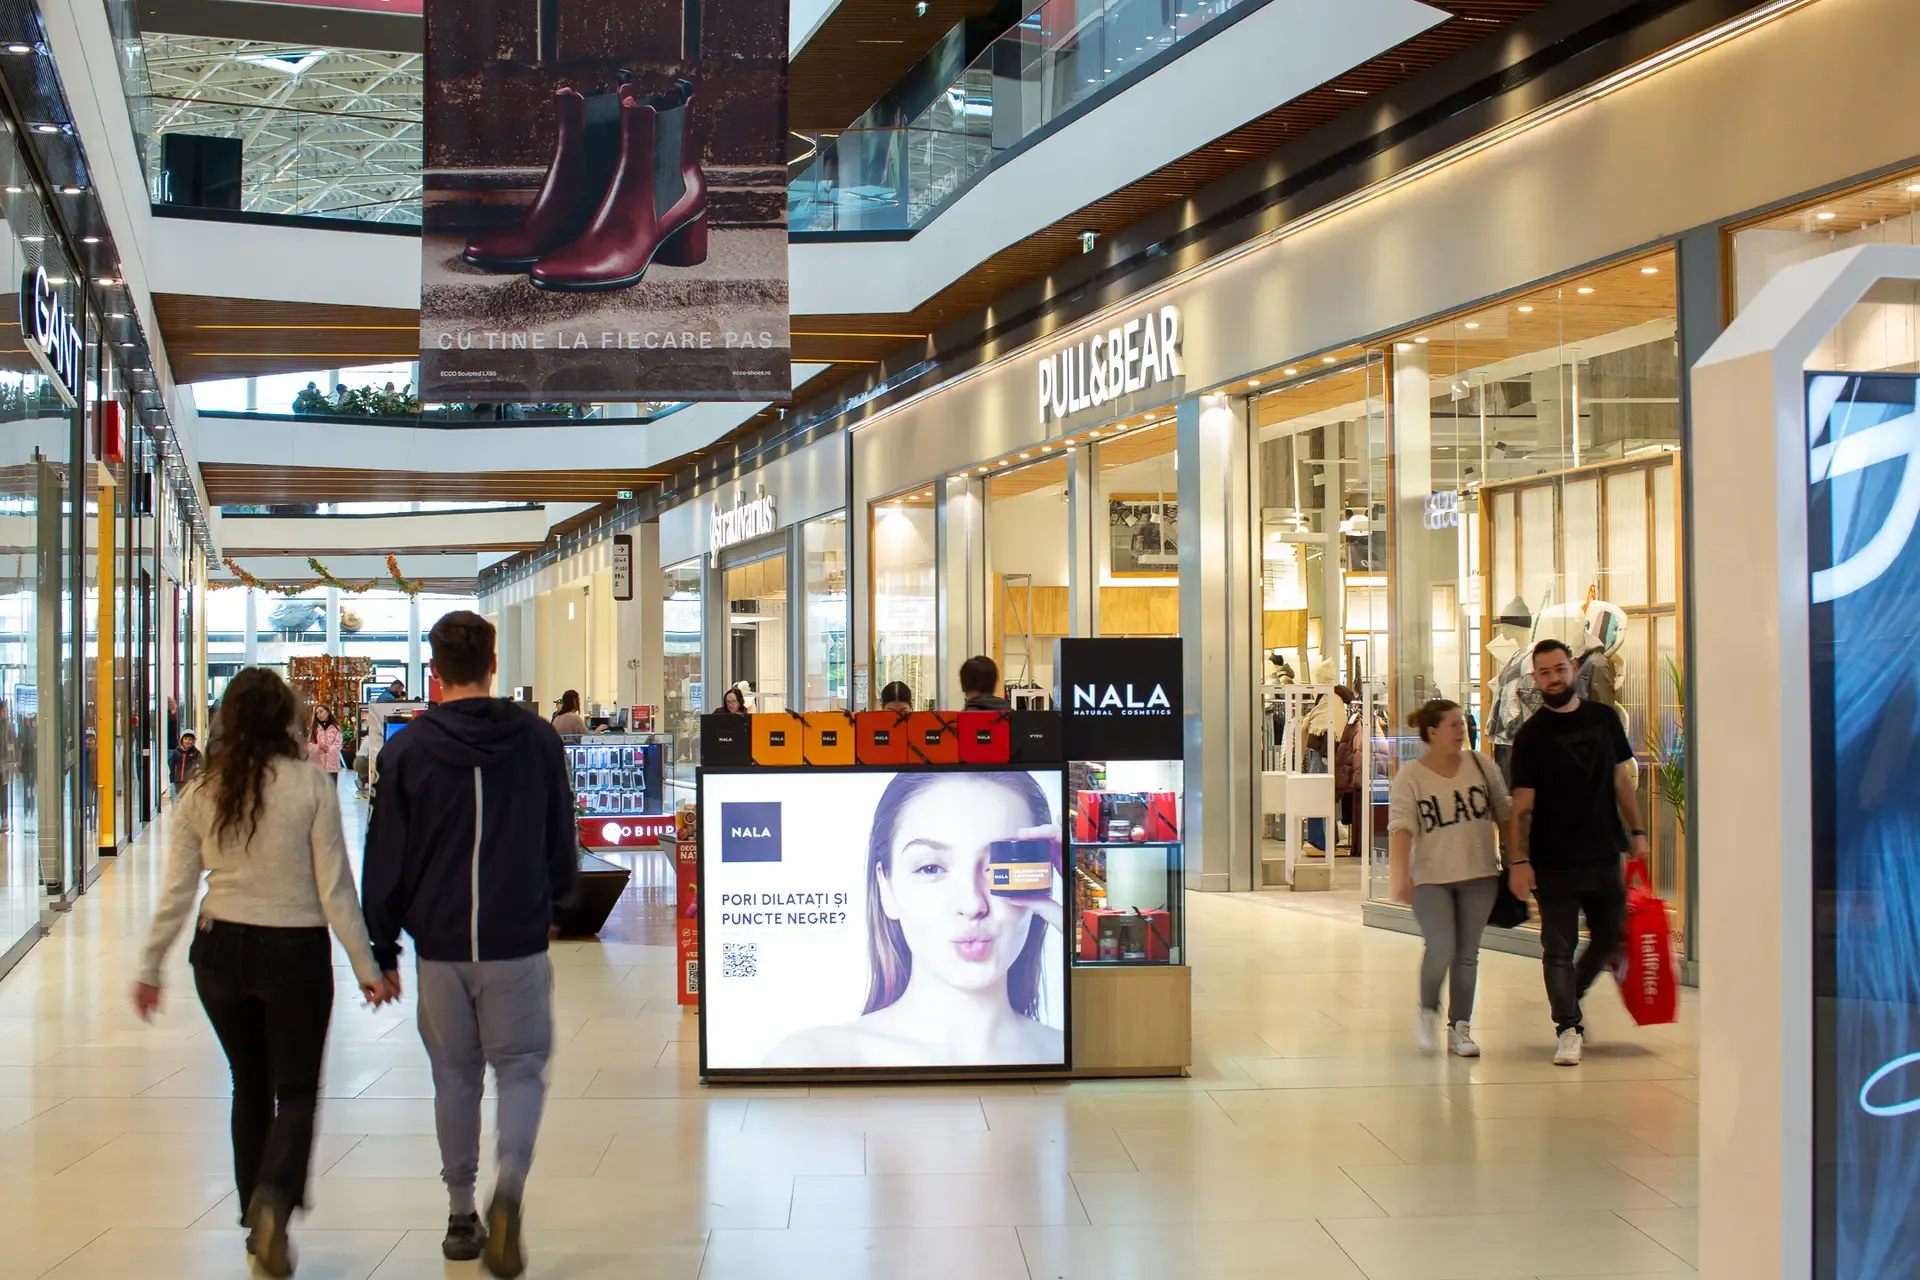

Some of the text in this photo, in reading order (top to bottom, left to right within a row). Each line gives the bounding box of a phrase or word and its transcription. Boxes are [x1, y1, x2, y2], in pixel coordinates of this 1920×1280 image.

[35, 265, 82, 397] GANT
[438, 331, 774, 350] CU TINE LA FIECARE PAS
[1039, 305, 1180, 424] PULL&BEAR
[1073, 683, 1171, 709] NALA
[731, 826, 772, 838] NALA
[722, 893, 848, 908] PORI DILATAȚI ȘI
[722, 912, 847, 925] PUNCTE NEGRE?
